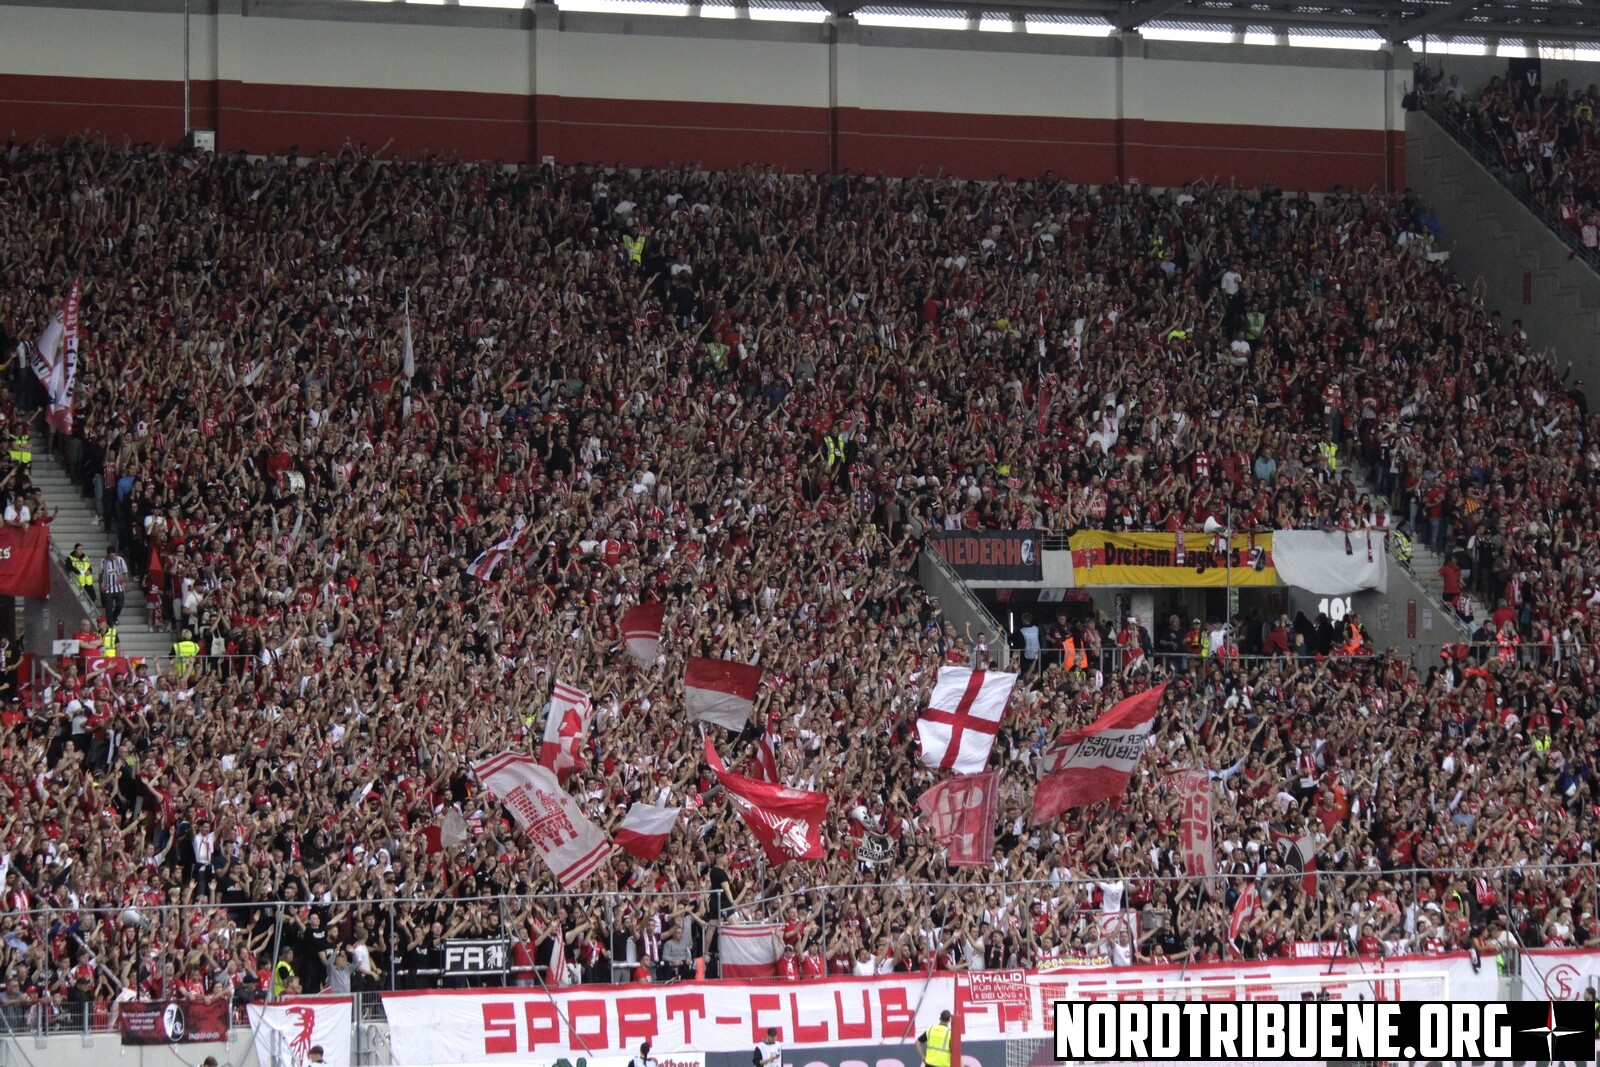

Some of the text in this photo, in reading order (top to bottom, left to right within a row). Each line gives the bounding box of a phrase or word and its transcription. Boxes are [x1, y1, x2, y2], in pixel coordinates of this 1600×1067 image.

[1104, 541, 1171, 566] Dreisam
[972, 972, 1023, 983] KHALID
[973, 983, 991, 992] FÜR
[482, 987, 915, 1054] SPORT-CLUB
